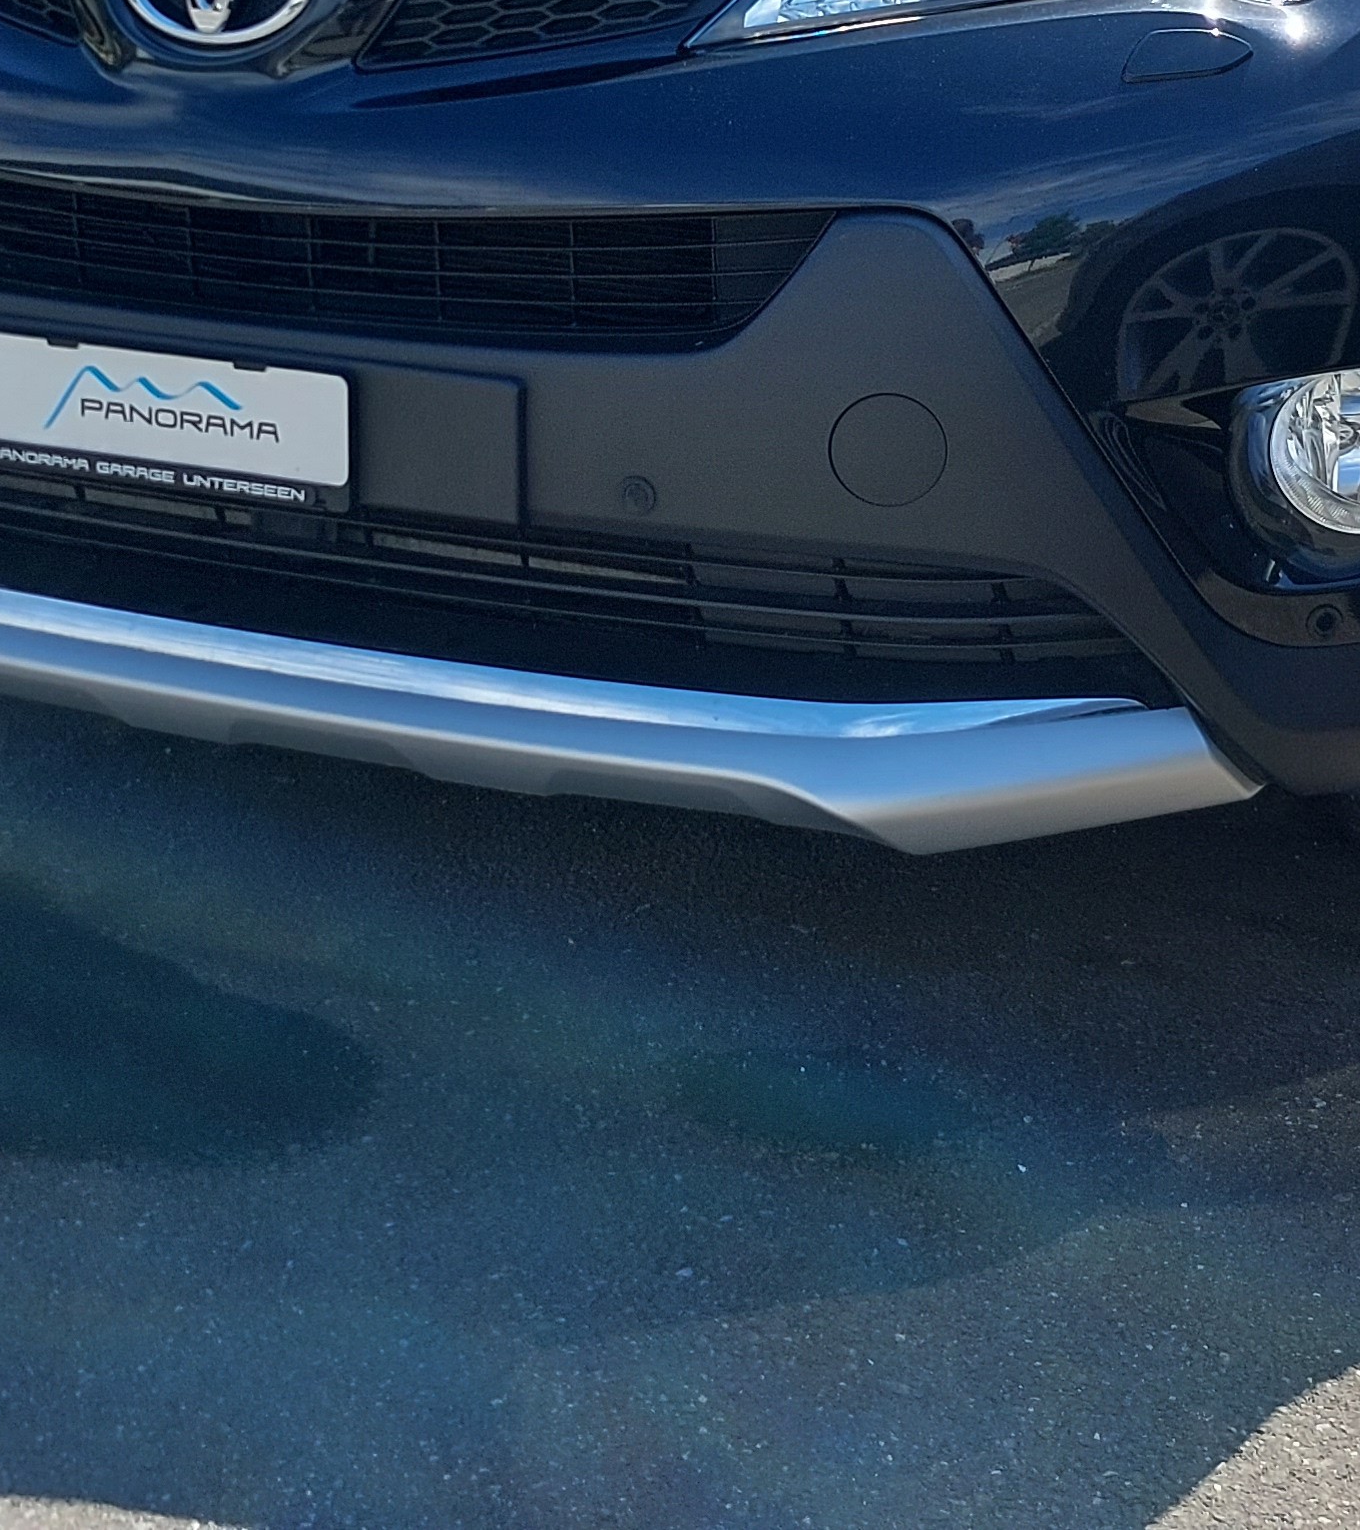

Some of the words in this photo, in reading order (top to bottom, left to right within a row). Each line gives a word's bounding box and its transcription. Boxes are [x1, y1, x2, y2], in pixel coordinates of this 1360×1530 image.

[80, 397, 280, 443] PANORAMA
[95, 460, 176, 484] GARAGE
[182, 473, 306, 503] UNTERSEEN
